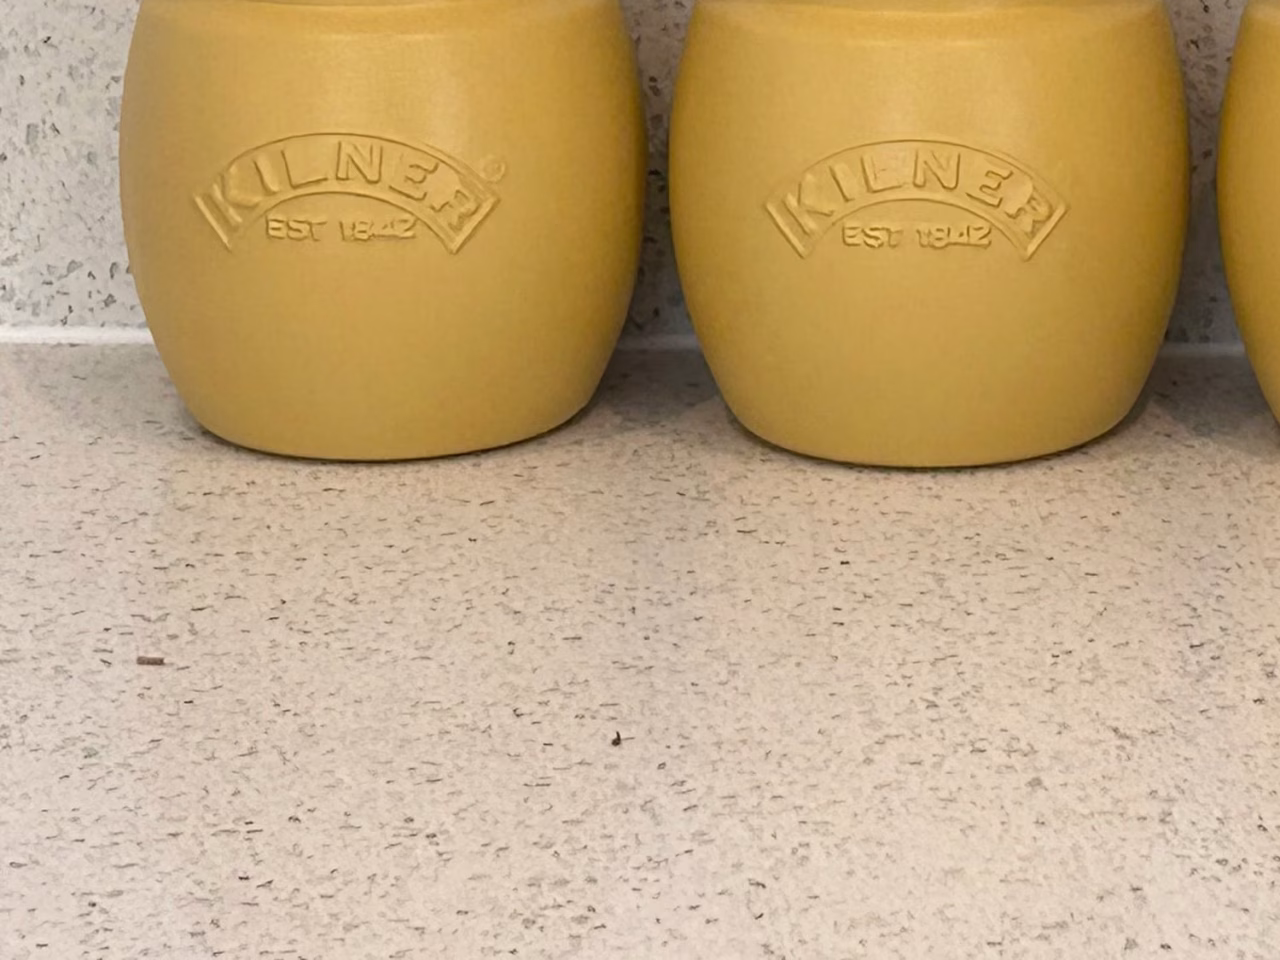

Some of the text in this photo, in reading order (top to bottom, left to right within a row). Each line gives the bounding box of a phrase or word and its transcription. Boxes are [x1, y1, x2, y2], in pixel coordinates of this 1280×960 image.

[213, 141, 482, 233] KILNER
[781, 150, 1054, 237] KILNER
[265, 217, 417, 241] EST 1842
[842, 225, 992, 249] EST 1842
